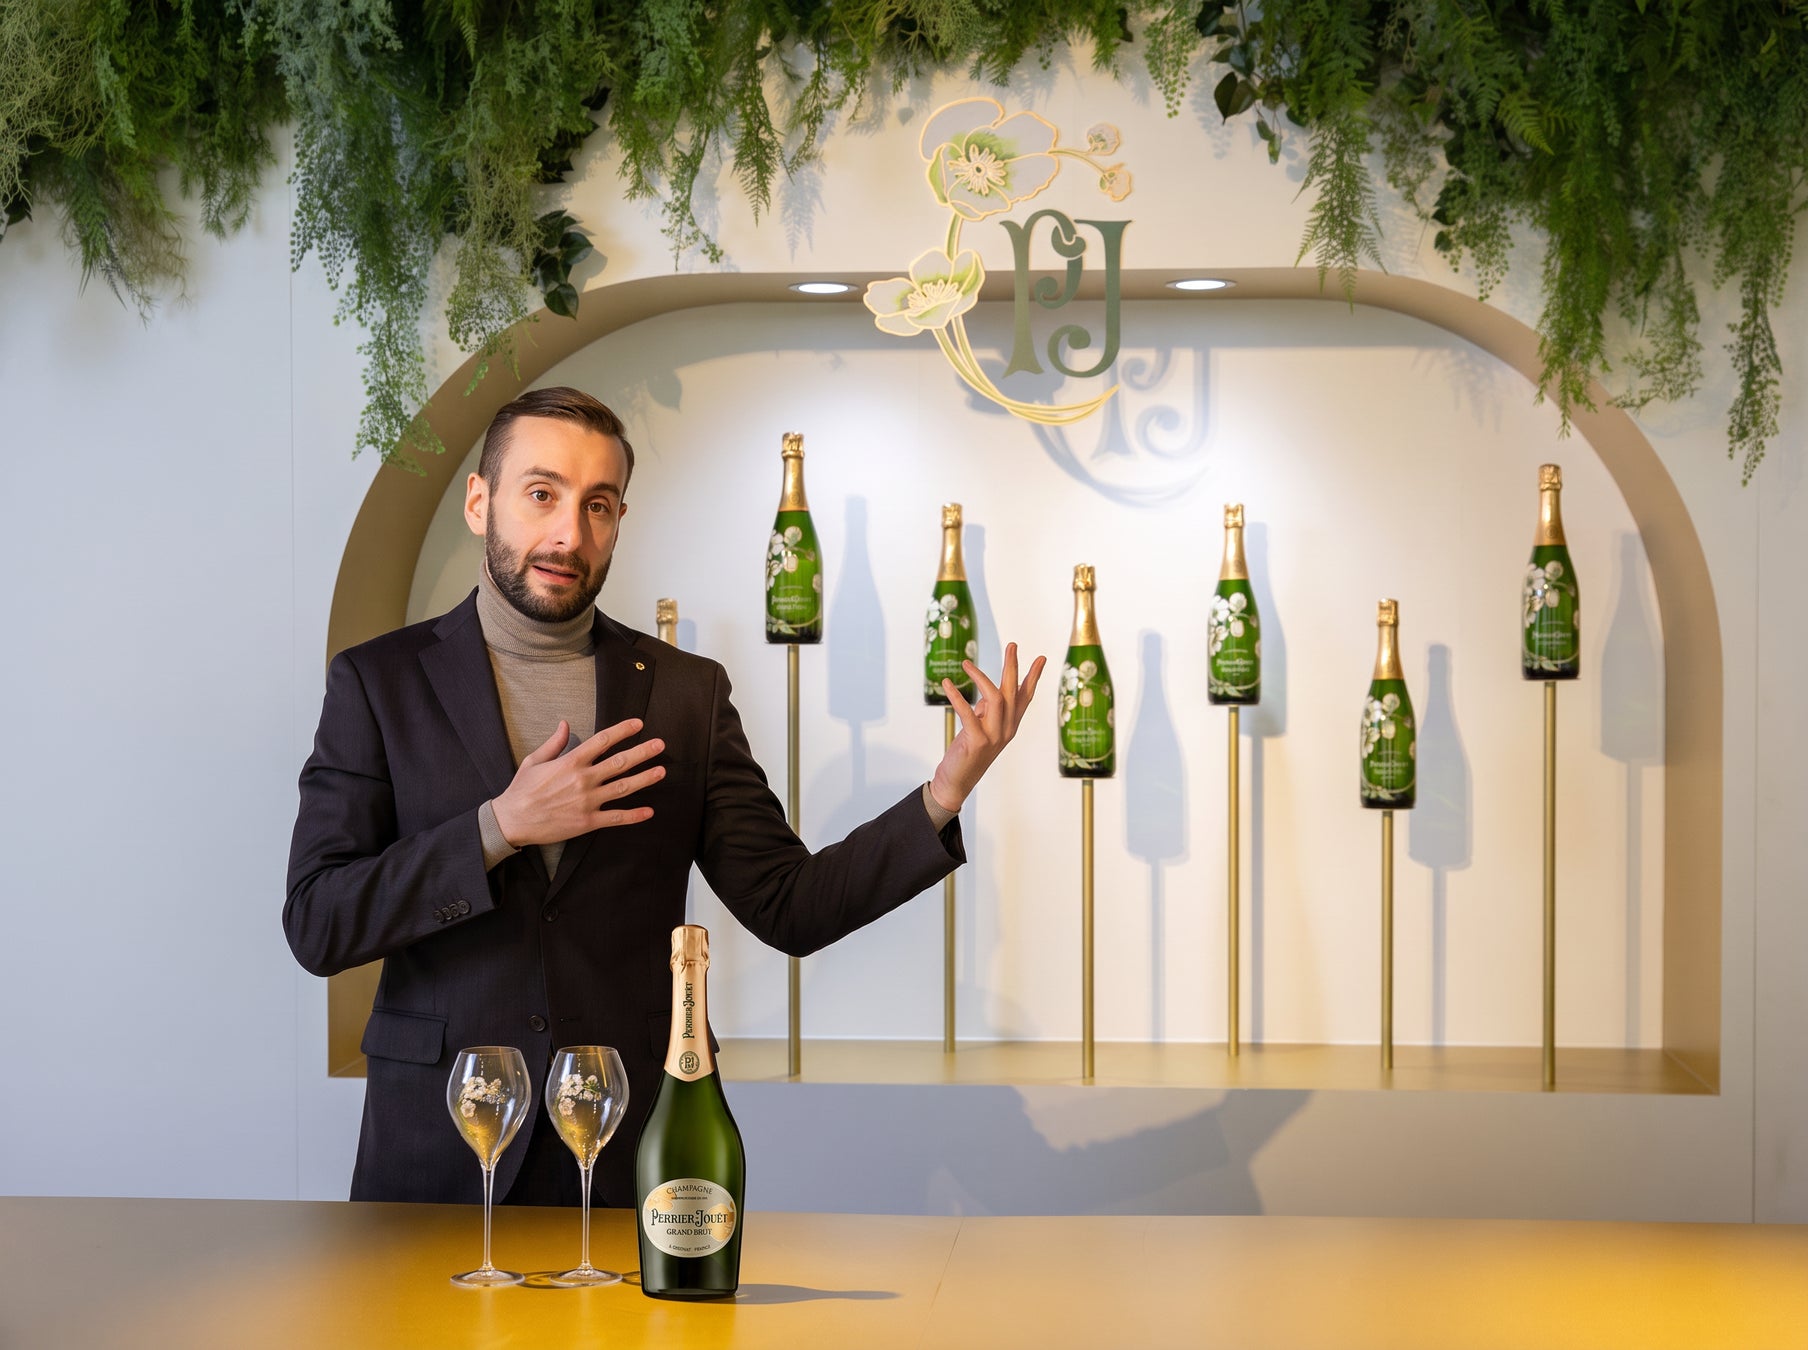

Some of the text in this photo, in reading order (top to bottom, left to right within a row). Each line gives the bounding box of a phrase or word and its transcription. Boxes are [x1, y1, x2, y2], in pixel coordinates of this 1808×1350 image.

[666, 1185, 713, 1195] CHAMPAGNE
[666, 1228, 712, 1236] GRAND BRUT
